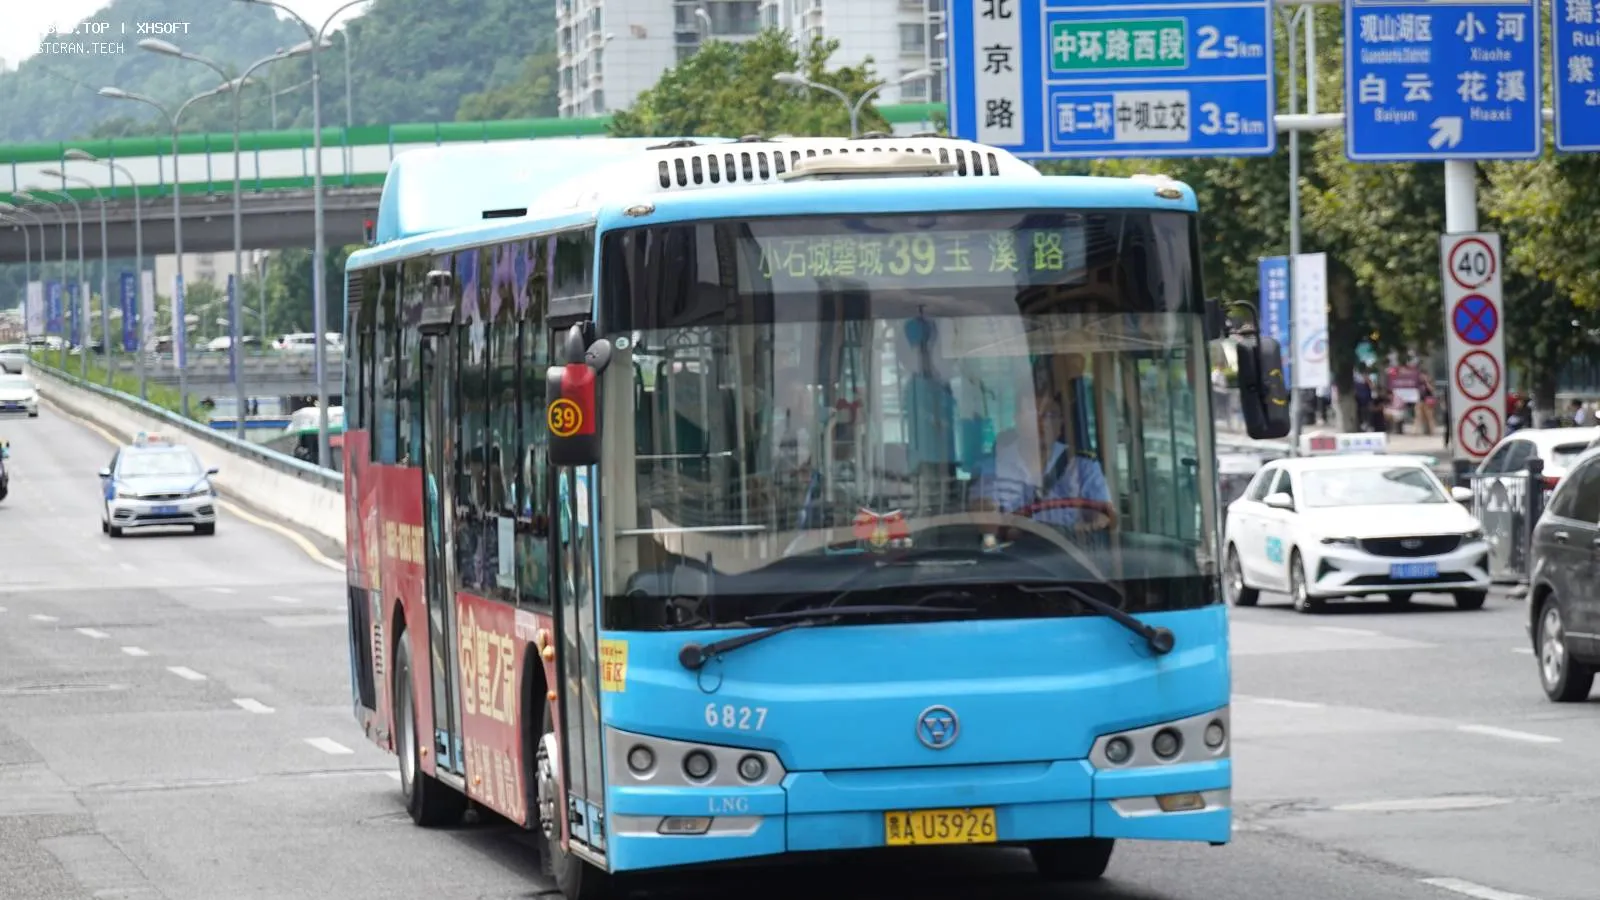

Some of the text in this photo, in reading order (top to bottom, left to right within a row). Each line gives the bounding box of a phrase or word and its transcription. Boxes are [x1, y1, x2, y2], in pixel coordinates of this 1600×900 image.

[1565, 0, 1600, 24] 瑞
[1359, 13, 1433, 43] 观山湖区
[1455, 12, 1526, 43] 小河
[1054, 26, 1264, 62] 中环路西段 2.5km
[1470, 47, 1512, 61] Xiaohe
[982, 0, 1015, 129] 北京路
[1358, 73, 1434, 104] 白云
[1456, 71, 1526, 103] 花溪
[1057, 101, 1265, 136] 西二环 中坝立交 3.5km
[1374, 107, 1418, 125] Baiyun
[1470, 106, 1512, 122] Huaxi
[887, 232, 936, 276] 39
[942, 230, 1064, 273] 玉溪路
[1456, 251, 1488, 277] 40
[553, 407, 576, 429] 39
[704, 702, 769, 731] 6827
[708, 796, 750, 813] LNG
